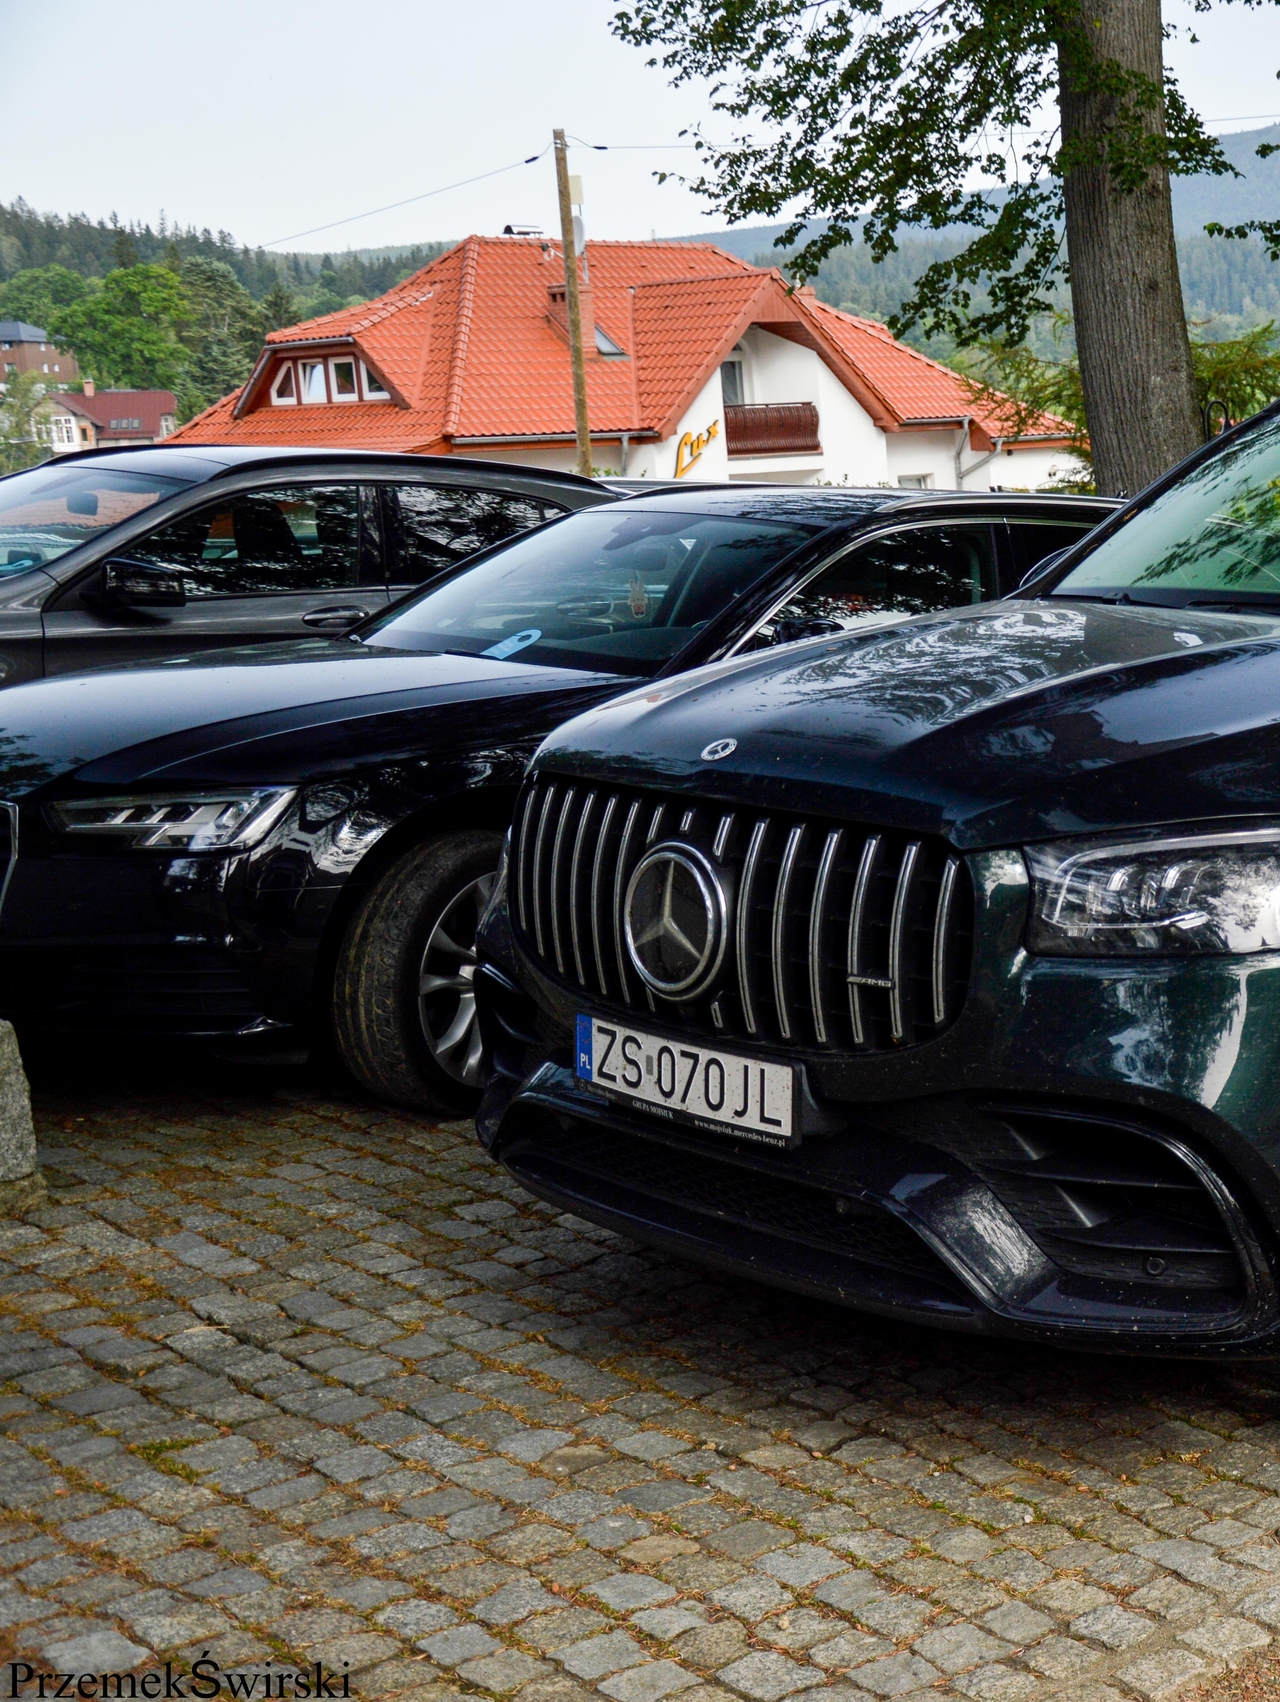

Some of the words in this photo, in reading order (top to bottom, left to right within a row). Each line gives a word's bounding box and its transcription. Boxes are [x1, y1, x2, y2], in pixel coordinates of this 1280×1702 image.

[674, 419, 720, 479] Lux
[861, 978, 892, 988] AMG
[579, 1053, 592, 1071] PL
[596, 1025, 643, 1089] ZS
[656, 1045, 783, 1128] 070JL
